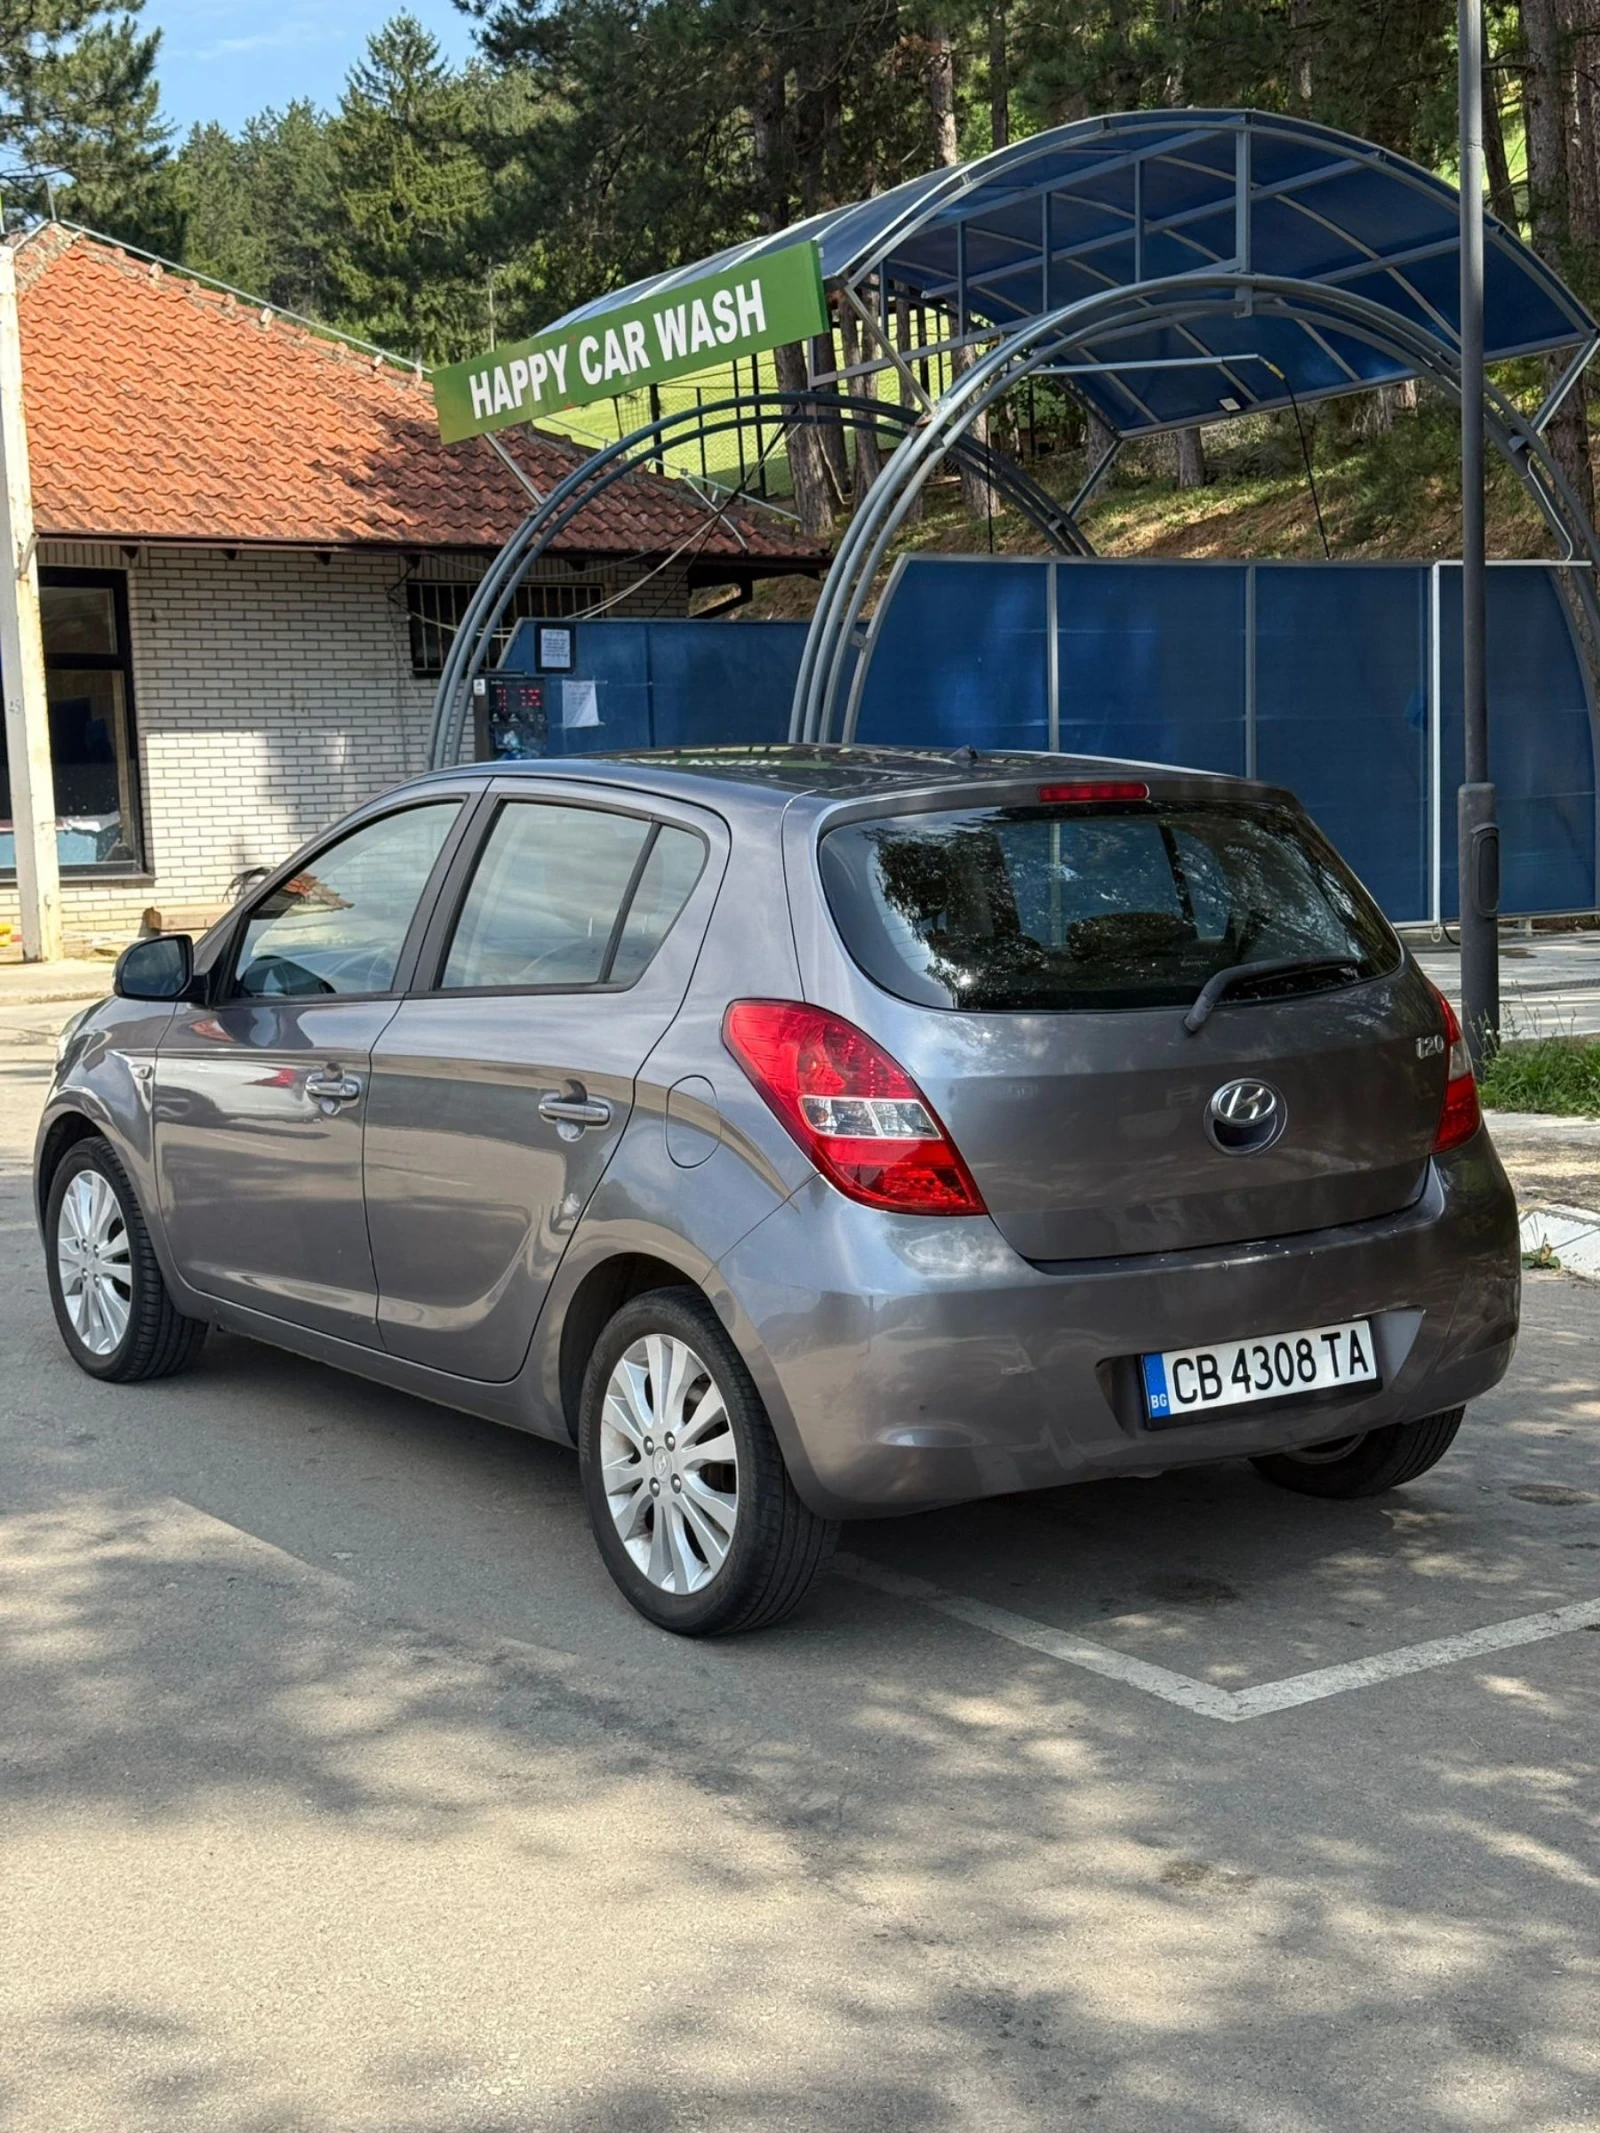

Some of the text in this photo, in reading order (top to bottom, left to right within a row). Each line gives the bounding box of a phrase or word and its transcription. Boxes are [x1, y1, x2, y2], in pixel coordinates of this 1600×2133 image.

[469, 279, 767, 419] HAPPY CAR WASH
[1151, 1394, 1168, 1409] BG
[1172, 1329, 1369, 1405] CB 4308 TA
